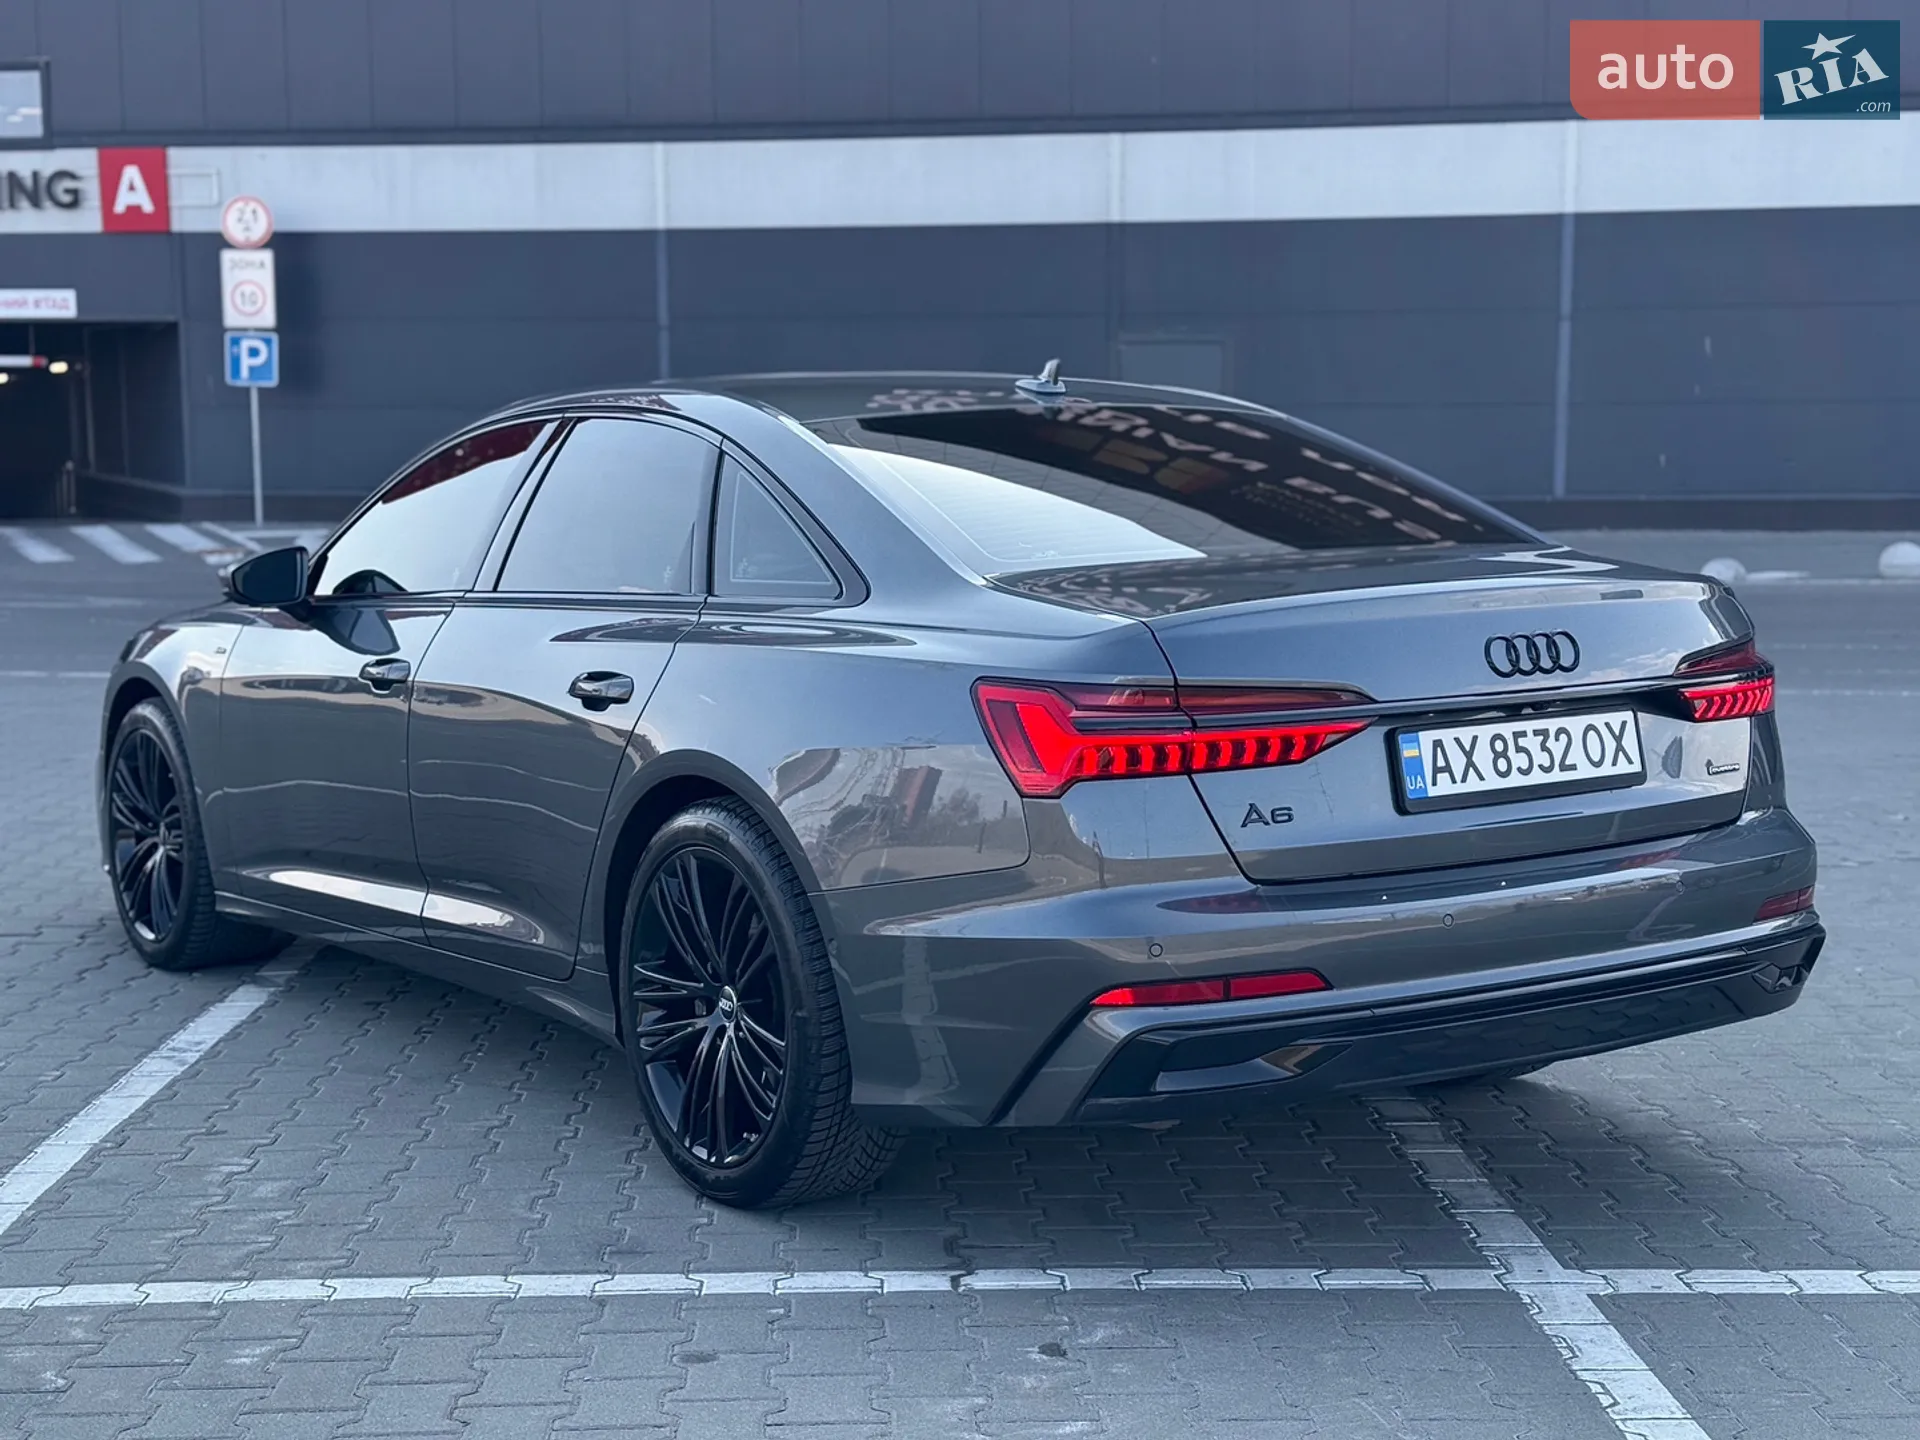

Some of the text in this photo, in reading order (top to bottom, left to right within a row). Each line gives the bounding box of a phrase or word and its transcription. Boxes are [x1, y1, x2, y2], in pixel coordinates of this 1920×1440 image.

[113, 164, 155, 215] A
[240, 338, 267, 381] P
[1431, 719, 1634, 787] AX 8532 OX
[1407, 775, 1425, 790] UA
[1241, 803, 1294, 828] A6
